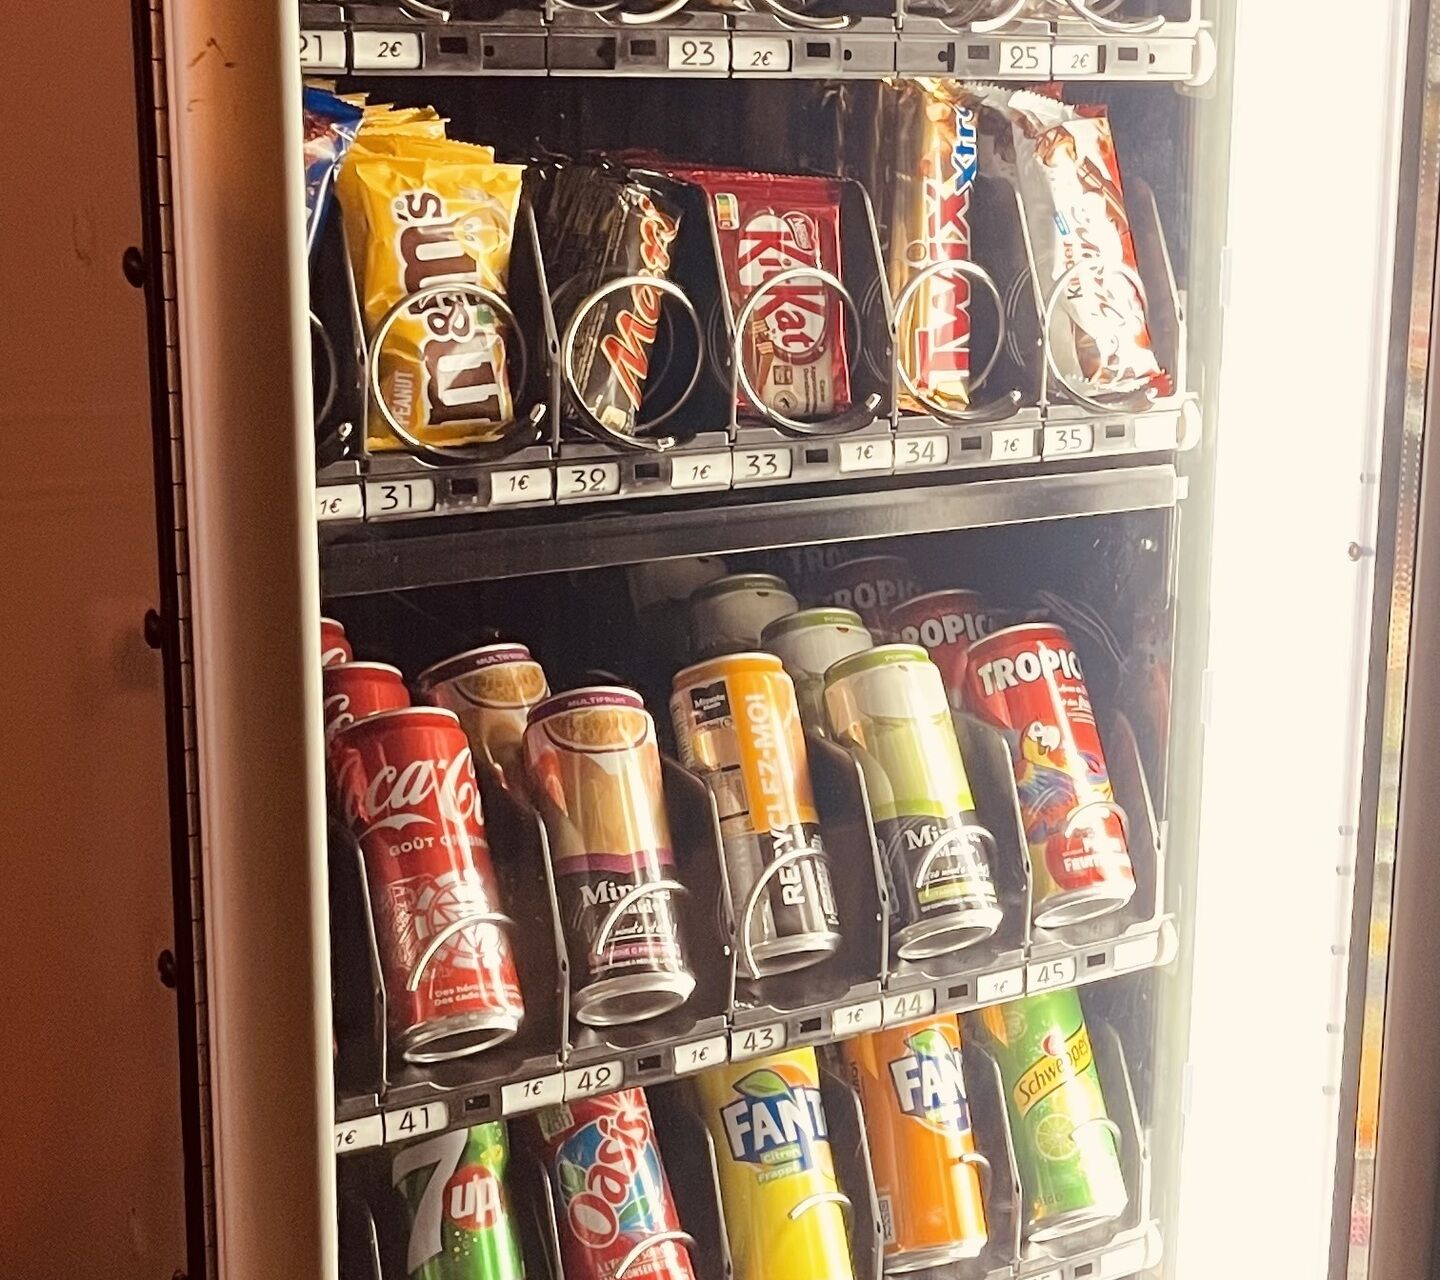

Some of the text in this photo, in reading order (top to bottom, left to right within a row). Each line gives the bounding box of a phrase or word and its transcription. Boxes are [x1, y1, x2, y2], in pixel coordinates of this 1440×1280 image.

[377, 41, 403, 59] 2€
[681, 42, 773, 67] 23 2€
[1010, 45, 1090, 70] 25 2€
[391, 369, 415, 423] PEANUT
[319, 428, 1084, 515] 1€ 31 1€ 32 1€ 33 1€ 34 1€ 35
[388, 836, 436, 857] GOÛT
[336, 962, 1064, 1148] 1€ 41 1€ 42 1€ 43 1€ 44 1€ 45
[391, 1126, 470, 1275] 7
[567, 1108, 650, 1250] Oasis
